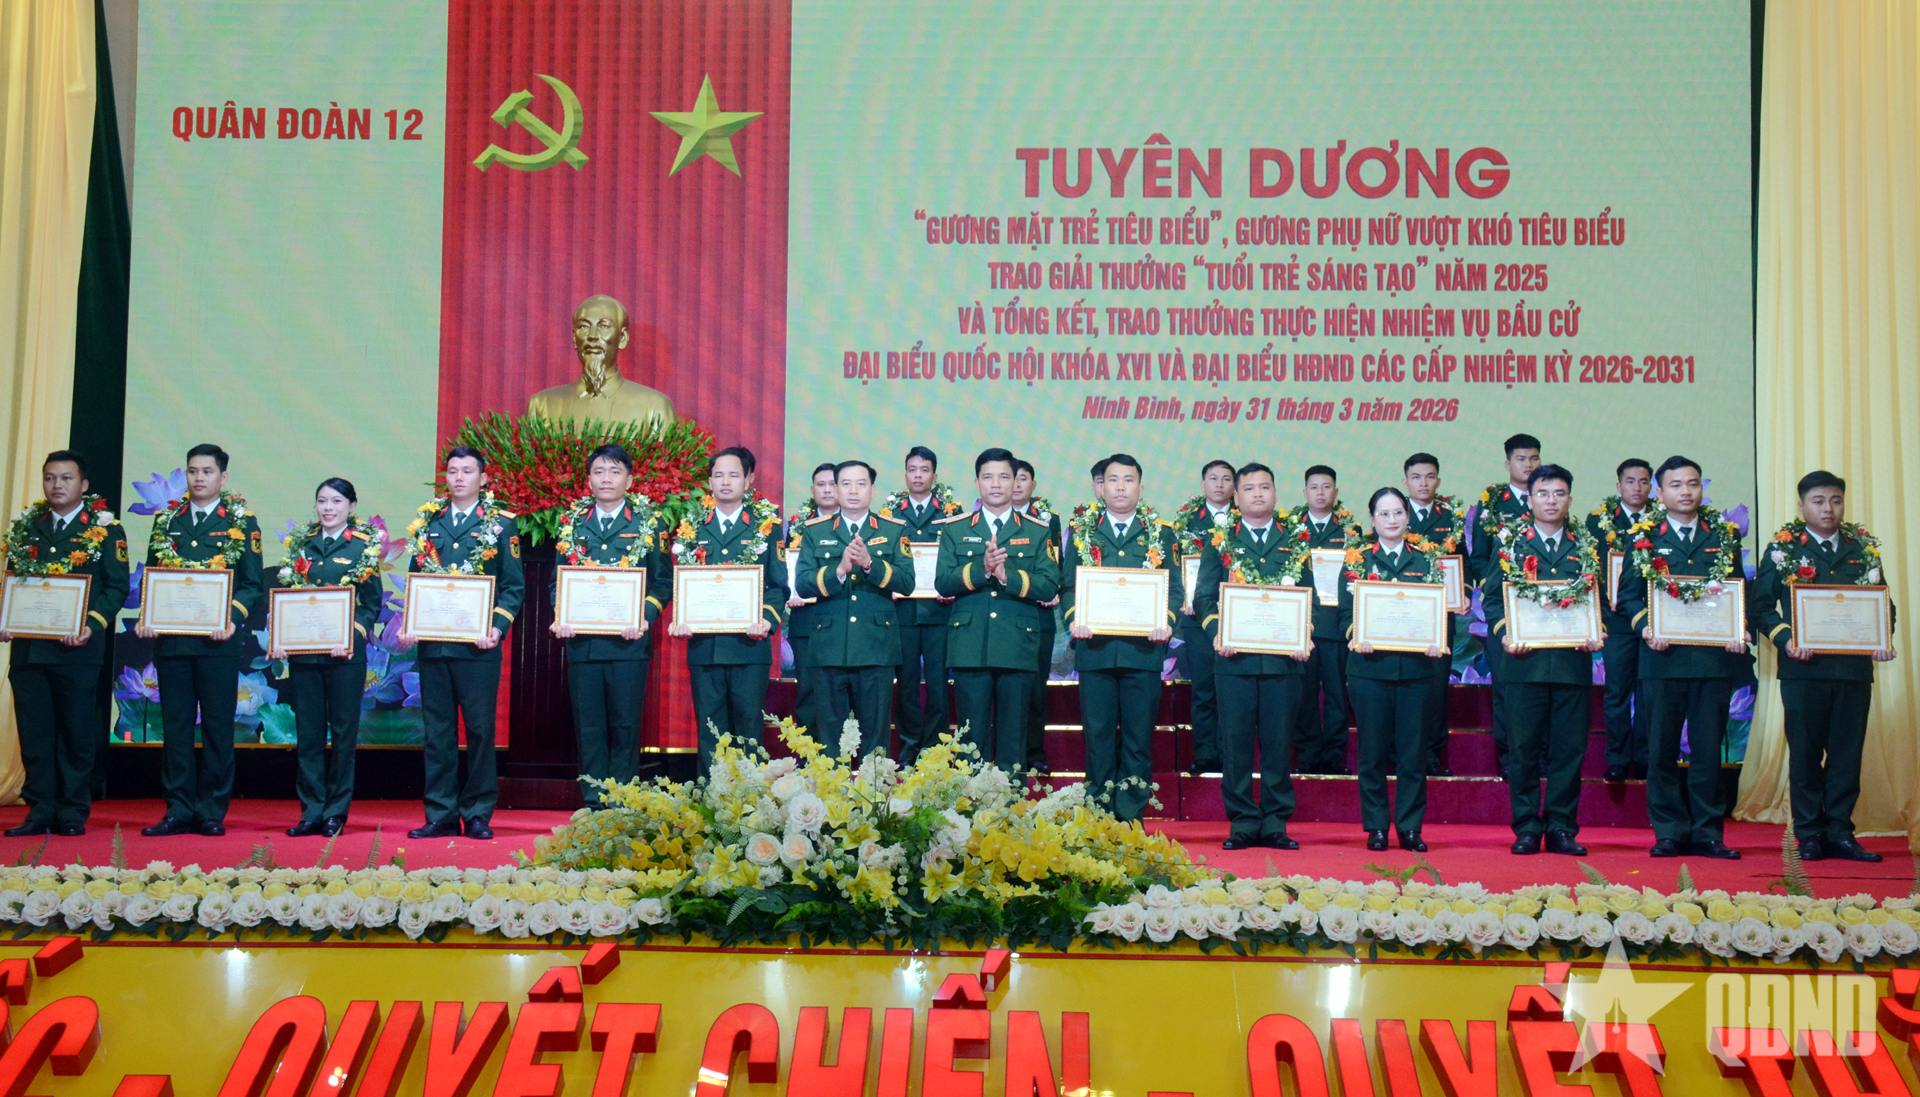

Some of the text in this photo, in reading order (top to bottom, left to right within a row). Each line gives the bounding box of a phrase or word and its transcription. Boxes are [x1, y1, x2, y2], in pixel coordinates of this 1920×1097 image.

[173, 101, 423, 142] QUÂN ĐOÀN 12
[1017, 133, 1510, 199] TUYÊN DƯƠNG
[1008, 212, 1054, 250] MẶT
[1061, 208, 1099, 244] TRẺ
[1107, 212, 1153, 245] TIÊU
[1237, 215, 1310, 245] GƯƠNG
[1318, 218, 1361, 251] PHỤ
[1369, 212, 1402, 245] NỮ
[1407, 215, 1462, 251] VƯỢT
[1469, 212, 1512, 245] KHÓ
[1520, 212, 1567, 245] TIÊU
[1575, 207, 1625, 245] BIỂU
[989, 262, 1042, 289] TRAO
[1050, 253, 1092, 289] GIẢI
[1100, 253, 1186, 290] THƯỞNG
[1261, 254, 1300, 290] TRẺ
[1308, 257, 1367, 291] SÁNG
[1436, 258, 1487, 291] NĂM
[1495, 264, 1548, 291] 2025
[959, 296, 1581, 343] VÀ TỔNG KẾT, TRAO THƯỞNG THỰC HIỆN NHIỆM VỤ BẦU CỬ
[844, 340, 1694, 389] ĐẠI BIỂU QUỐC HỘI KHÓA XVI VÀ ĐẠI BIỂU HĐND CÁC CẤP NHIỆM KỲ 2026-2031
[1083, 396, 1459, 423] Ninh Bình, ngày 31 tháng 3 năm 2026
[217, 943, 662, 1097] QUYẾT
[695, 949, 1091, 1097] CHIẾN
